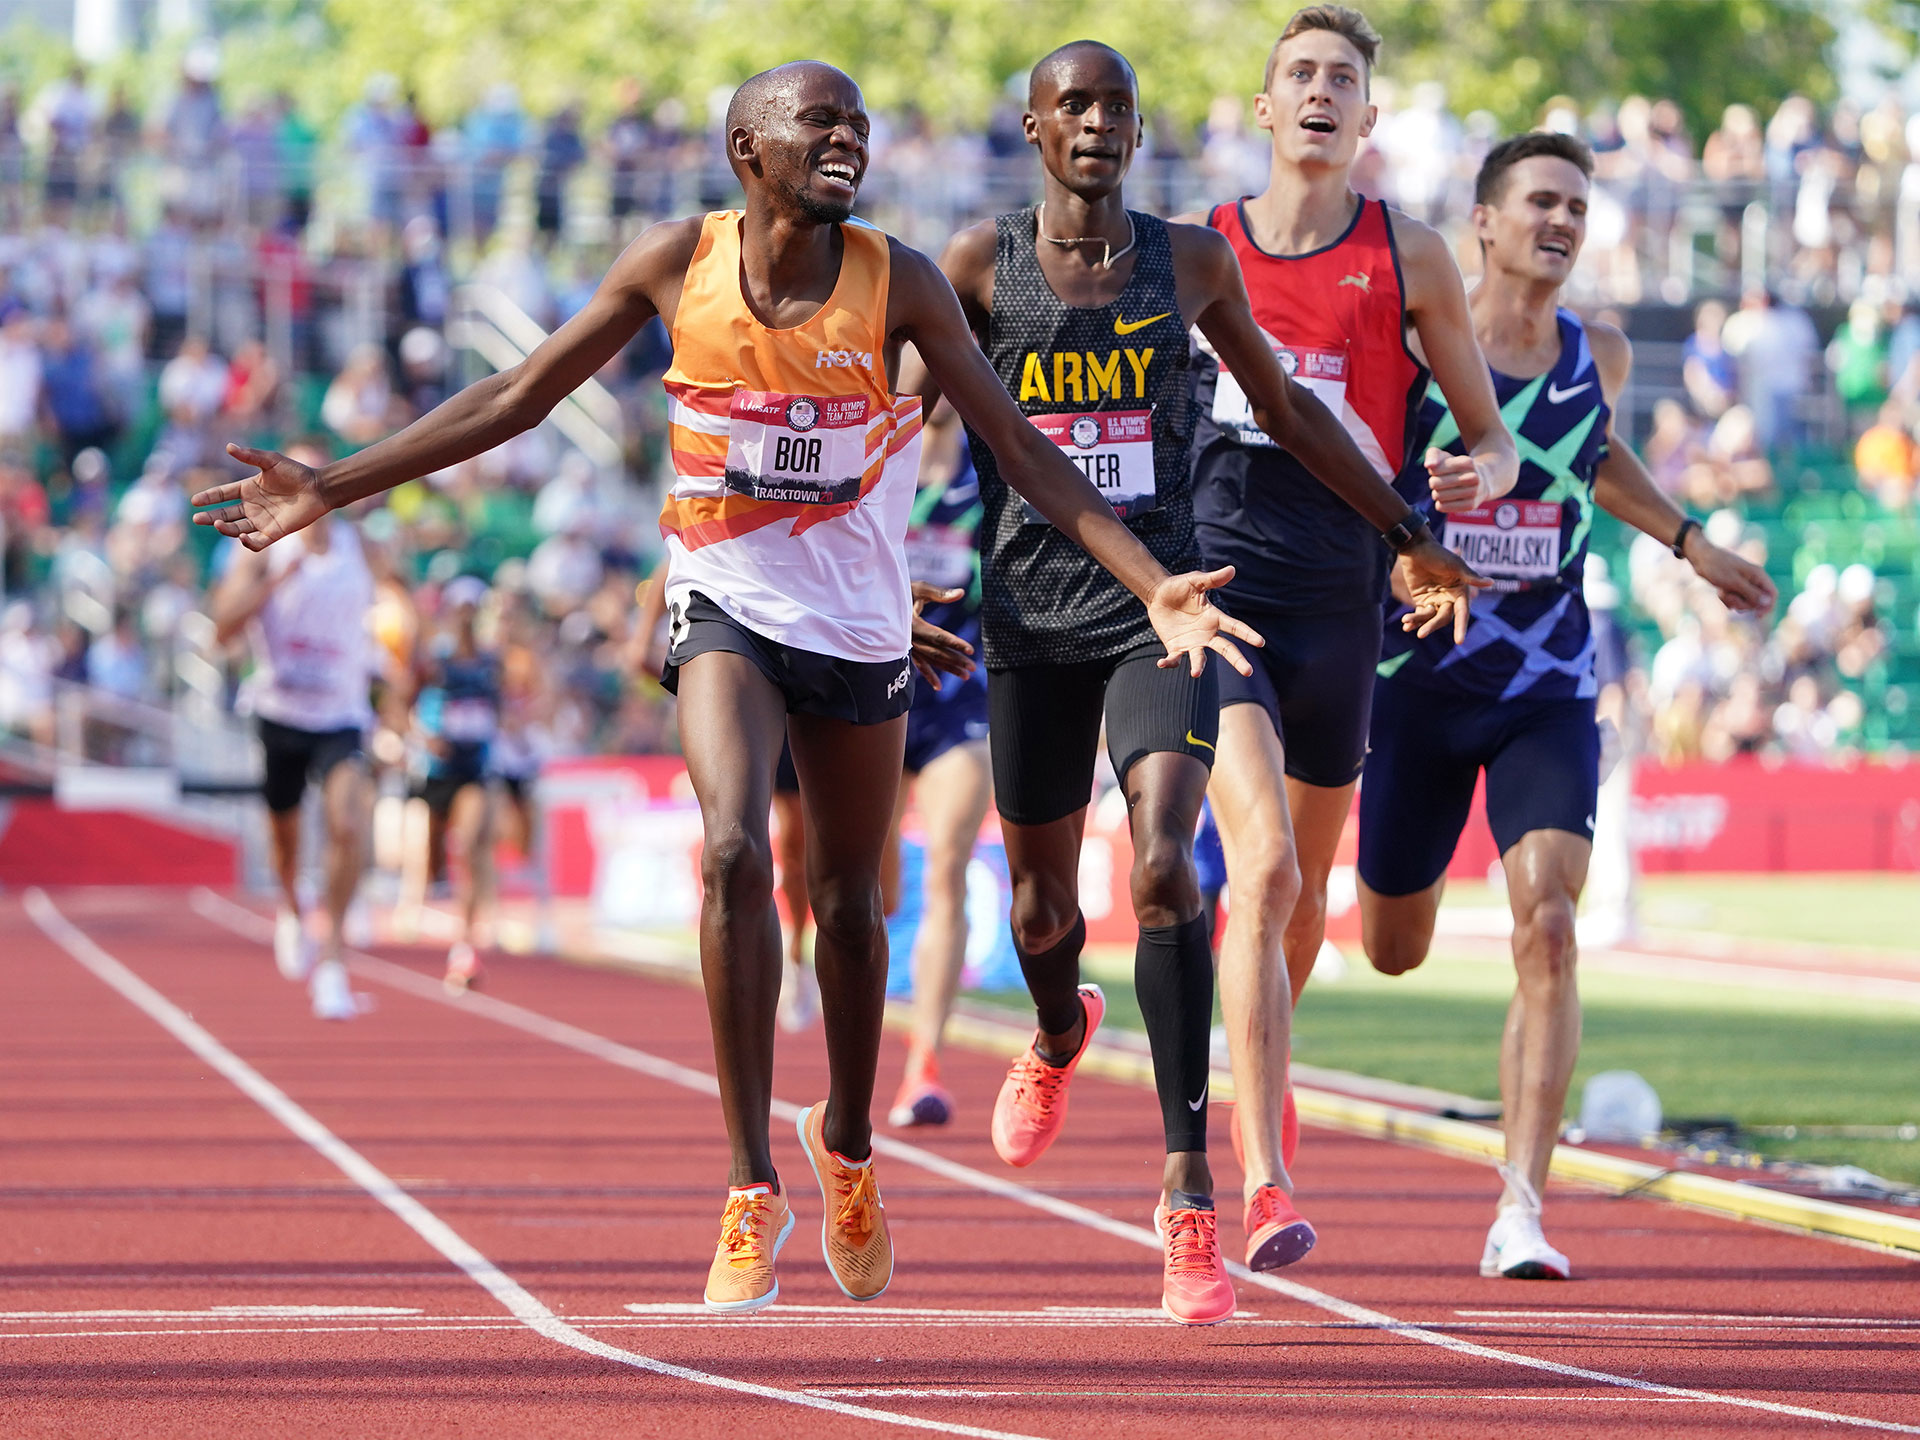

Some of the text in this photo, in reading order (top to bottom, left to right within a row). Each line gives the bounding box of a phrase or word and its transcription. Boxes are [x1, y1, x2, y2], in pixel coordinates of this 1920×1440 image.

[815, 350, 873, 371] HOKA
[1019, 347, 1154, 402] ARMY
[751, 404, 780, 414] USATF
[827, 400, 866, 412] U.S. OLYMPIC
[827, 410, 863, 421] TEAM TRIALS
[1108, 425, 1146, 436] TEAM TRIALS
[774, 436, 823, 473] BOR
[1453, 533, 1553, 566] MICHALSKI
